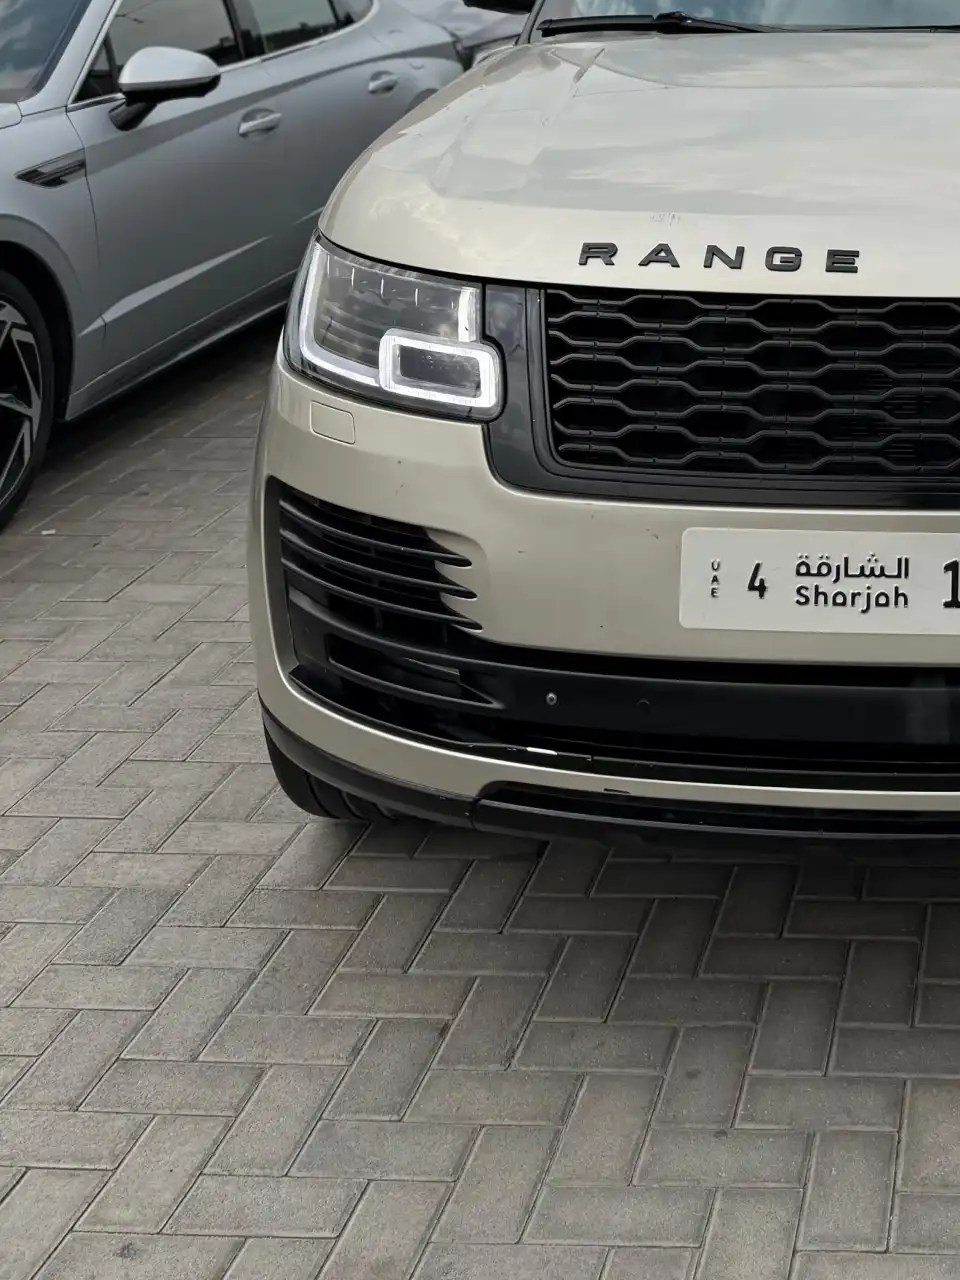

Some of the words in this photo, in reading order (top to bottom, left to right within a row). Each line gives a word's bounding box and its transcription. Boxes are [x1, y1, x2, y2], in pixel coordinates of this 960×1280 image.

[578, 242, 861, 273] RANGE
[747, 560, 768, 599] 4
[795, 552, 910, 584] الشارقة
[795, 584, 909, 614] Sharjah
